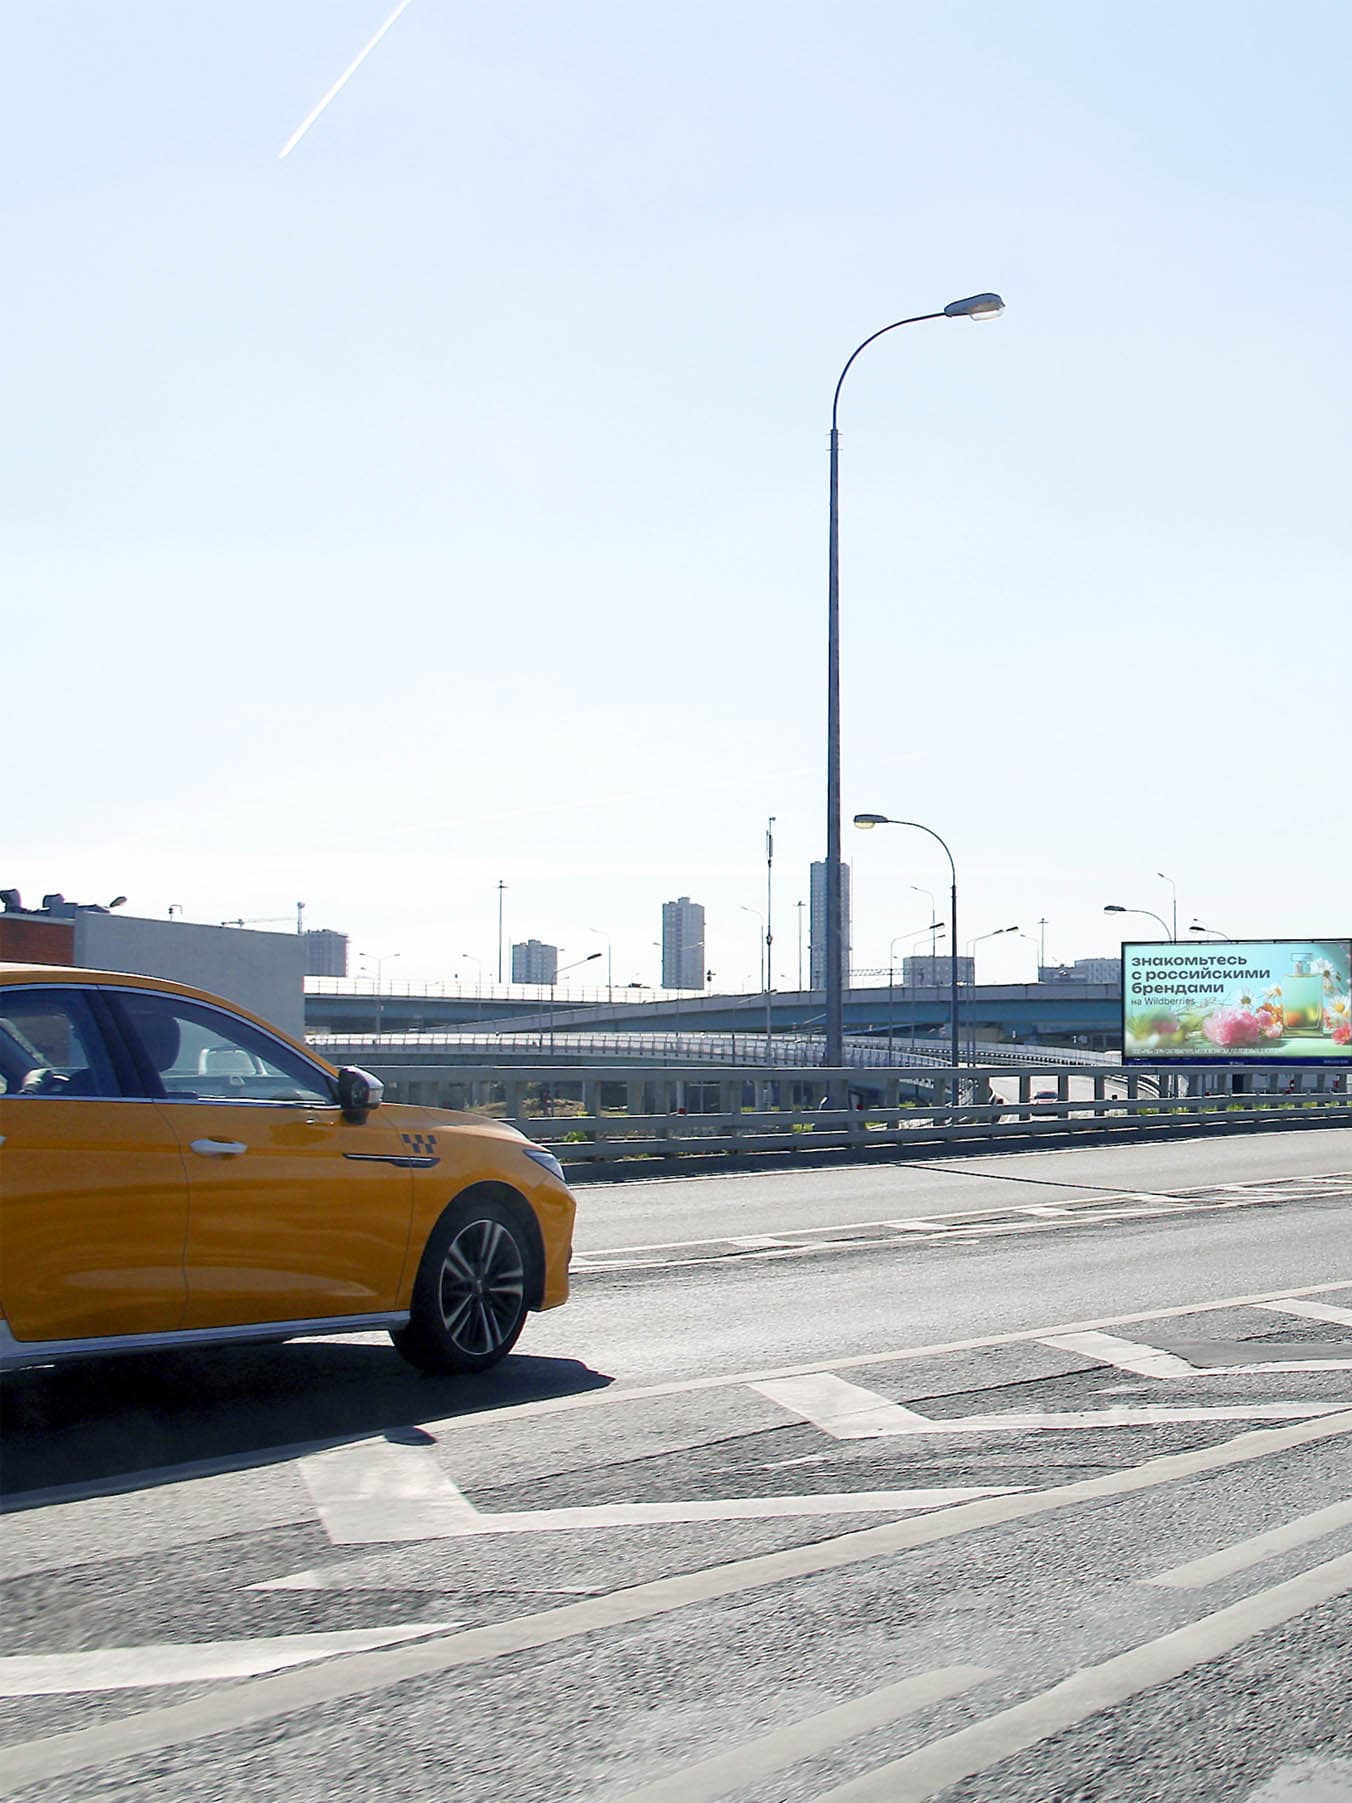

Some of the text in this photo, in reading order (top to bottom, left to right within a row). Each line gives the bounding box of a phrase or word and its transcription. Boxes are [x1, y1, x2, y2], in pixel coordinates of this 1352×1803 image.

[1131, 955, 1247, 967] знакомьтесь
[1131, 967, 1270, 982] с российскими
[1131, 982, 1224, 995] брендами
[1131, 997, 1196, 1006] на Wildberries
